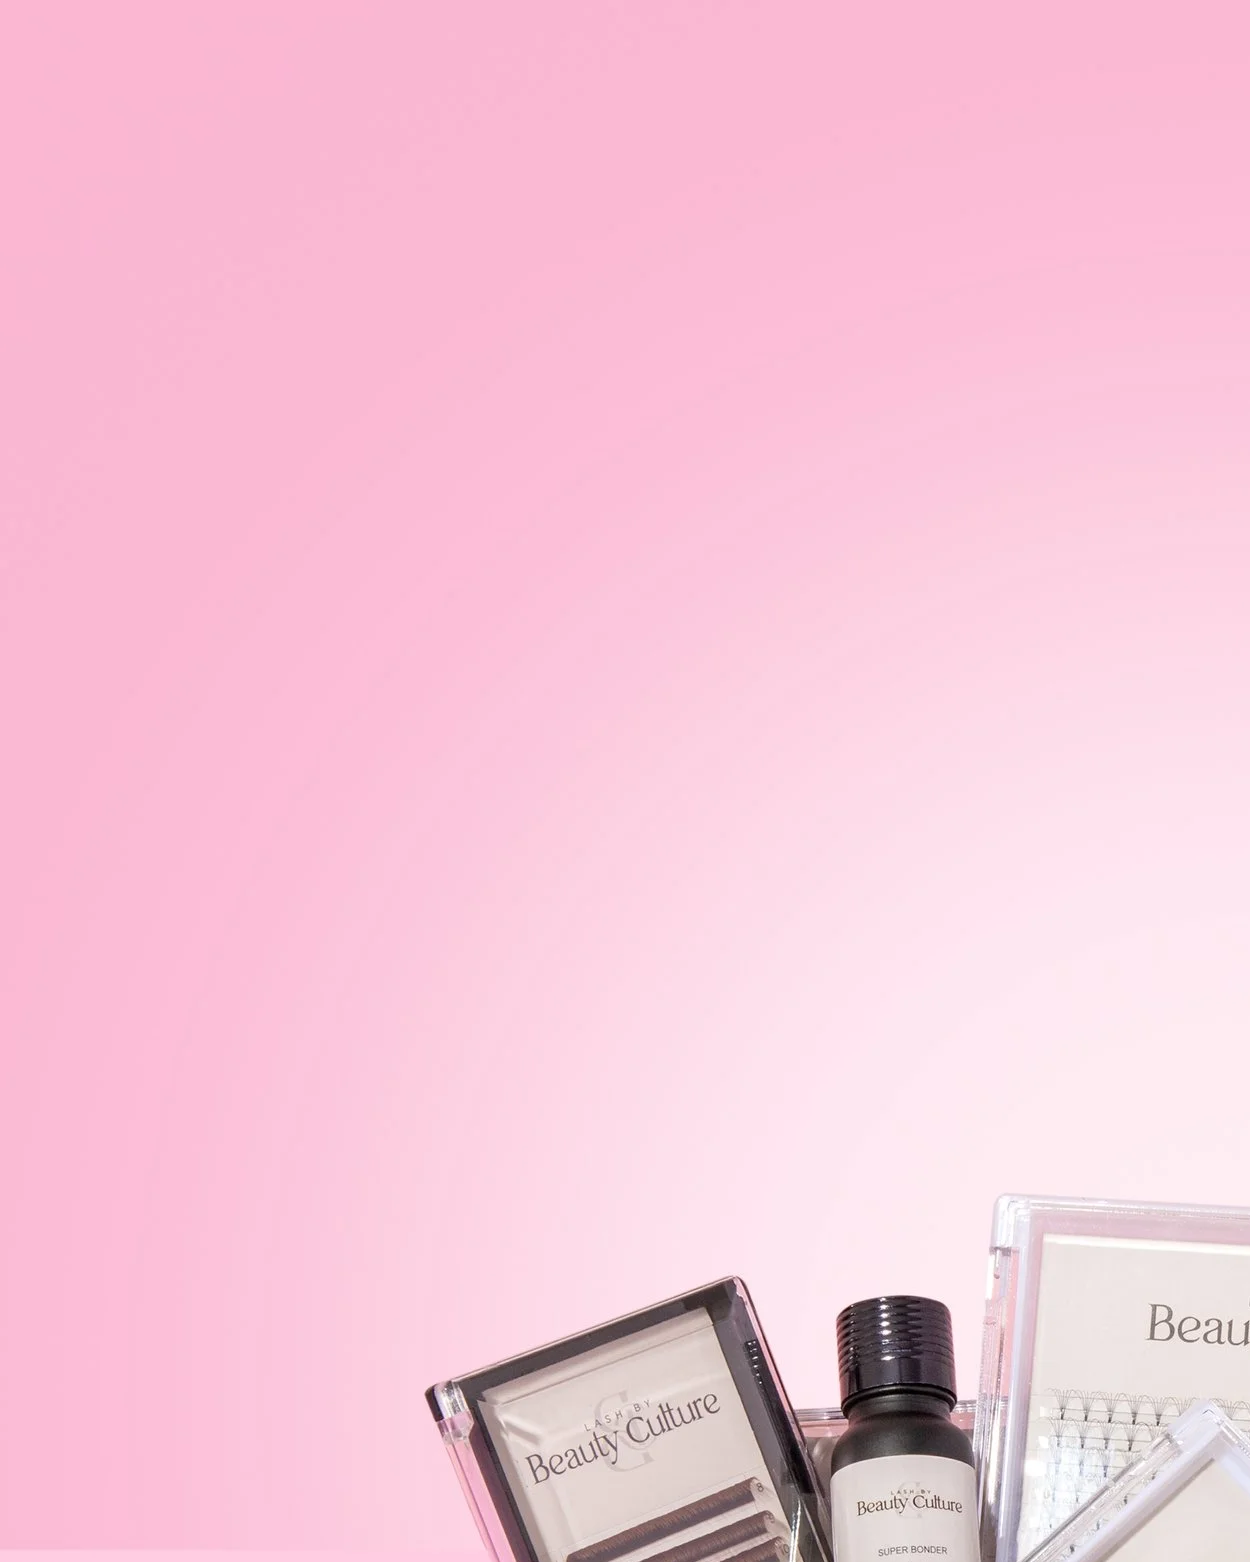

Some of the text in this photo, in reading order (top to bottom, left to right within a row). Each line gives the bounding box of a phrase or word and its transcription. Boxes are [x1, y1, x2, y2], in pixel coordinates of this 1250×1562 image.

[584, 1399, 651, 1432] LASH BY
[525, 1393, 721, 1485] Beauty Culture
[756, 1482, 765, 1493] 8
[857, 1494, 963, 1516] Beauty Culture
[878, 1545, 948, 1557] SUPER BONDER
